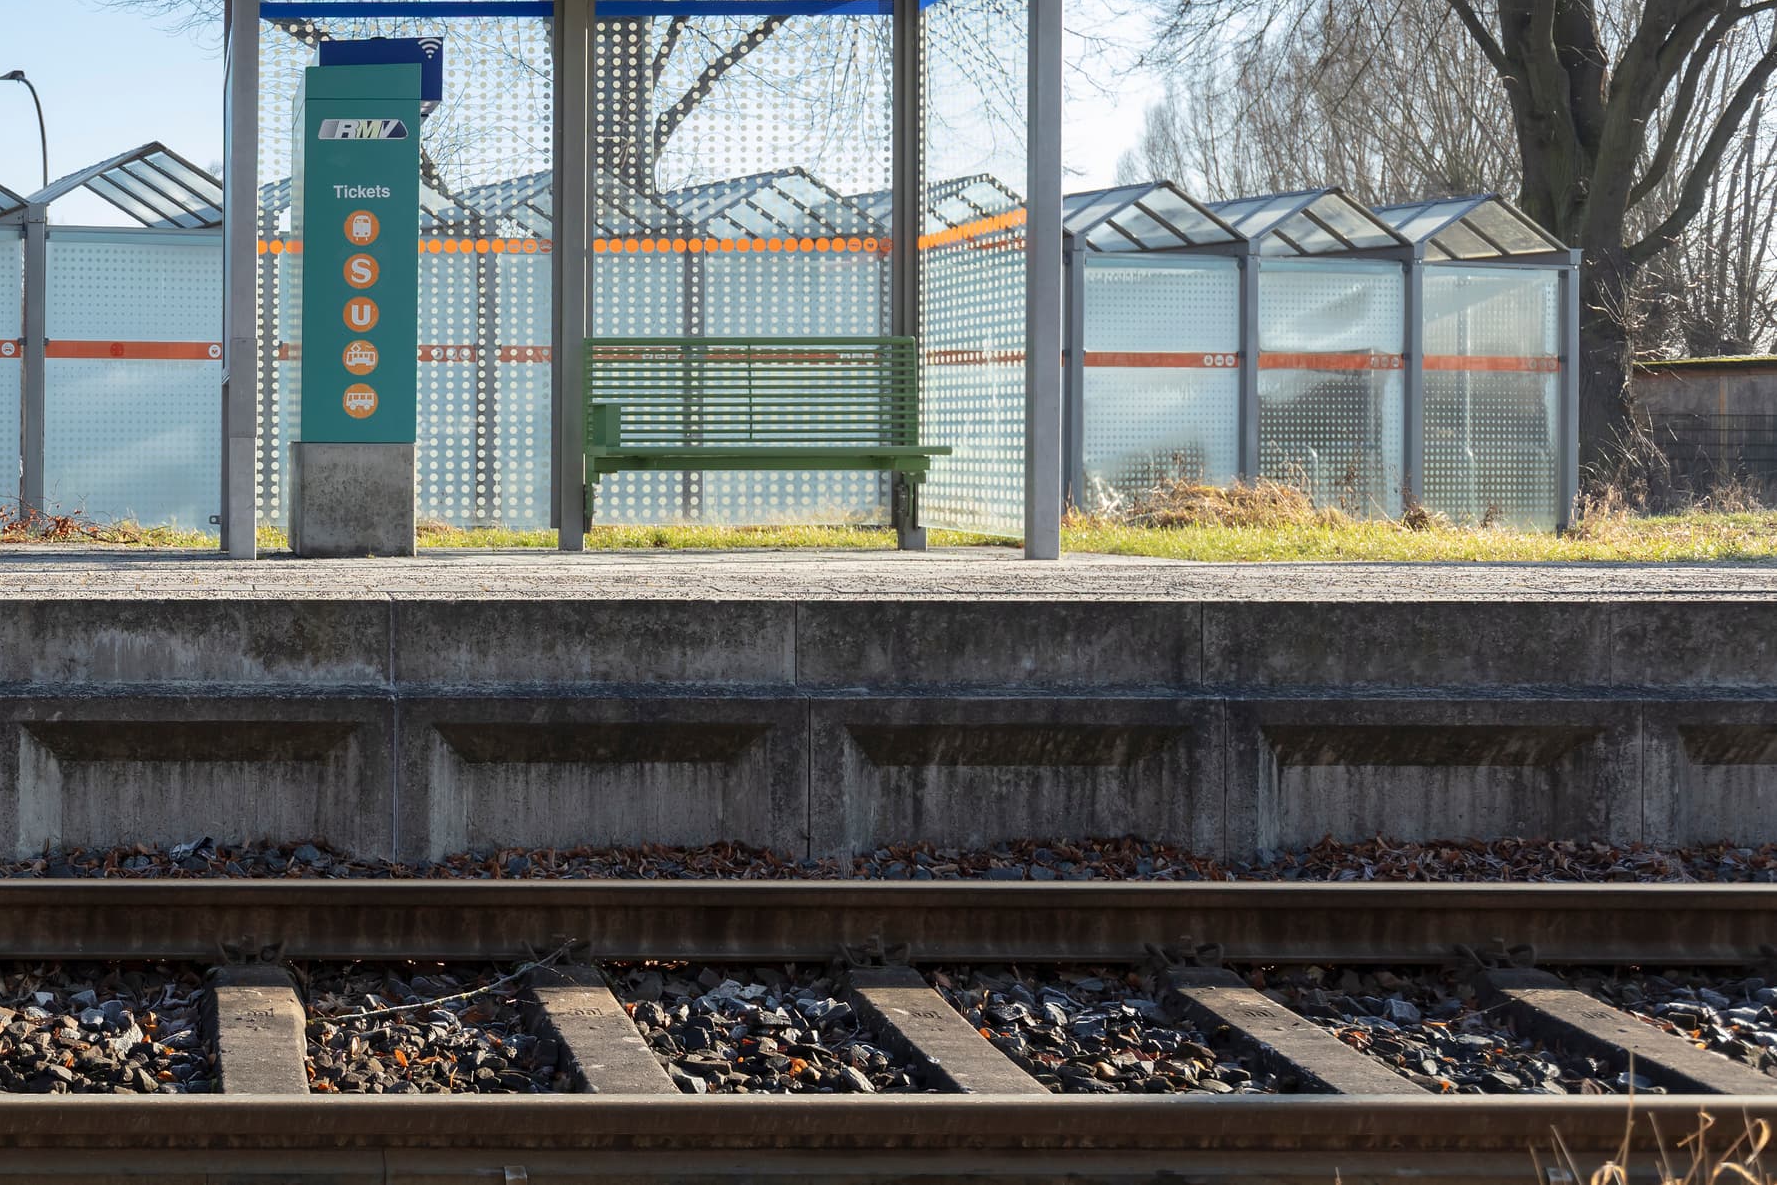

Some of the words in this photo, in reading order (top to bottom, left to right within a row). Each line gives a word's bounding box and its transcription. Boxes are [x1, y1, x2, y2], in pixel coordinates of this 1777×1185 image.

[334, 118, 400, 140] RMV
[333, 184, 391, 199] Tickets
[350, 258, 372, 284] S
[351, 304, 371, 326] U
